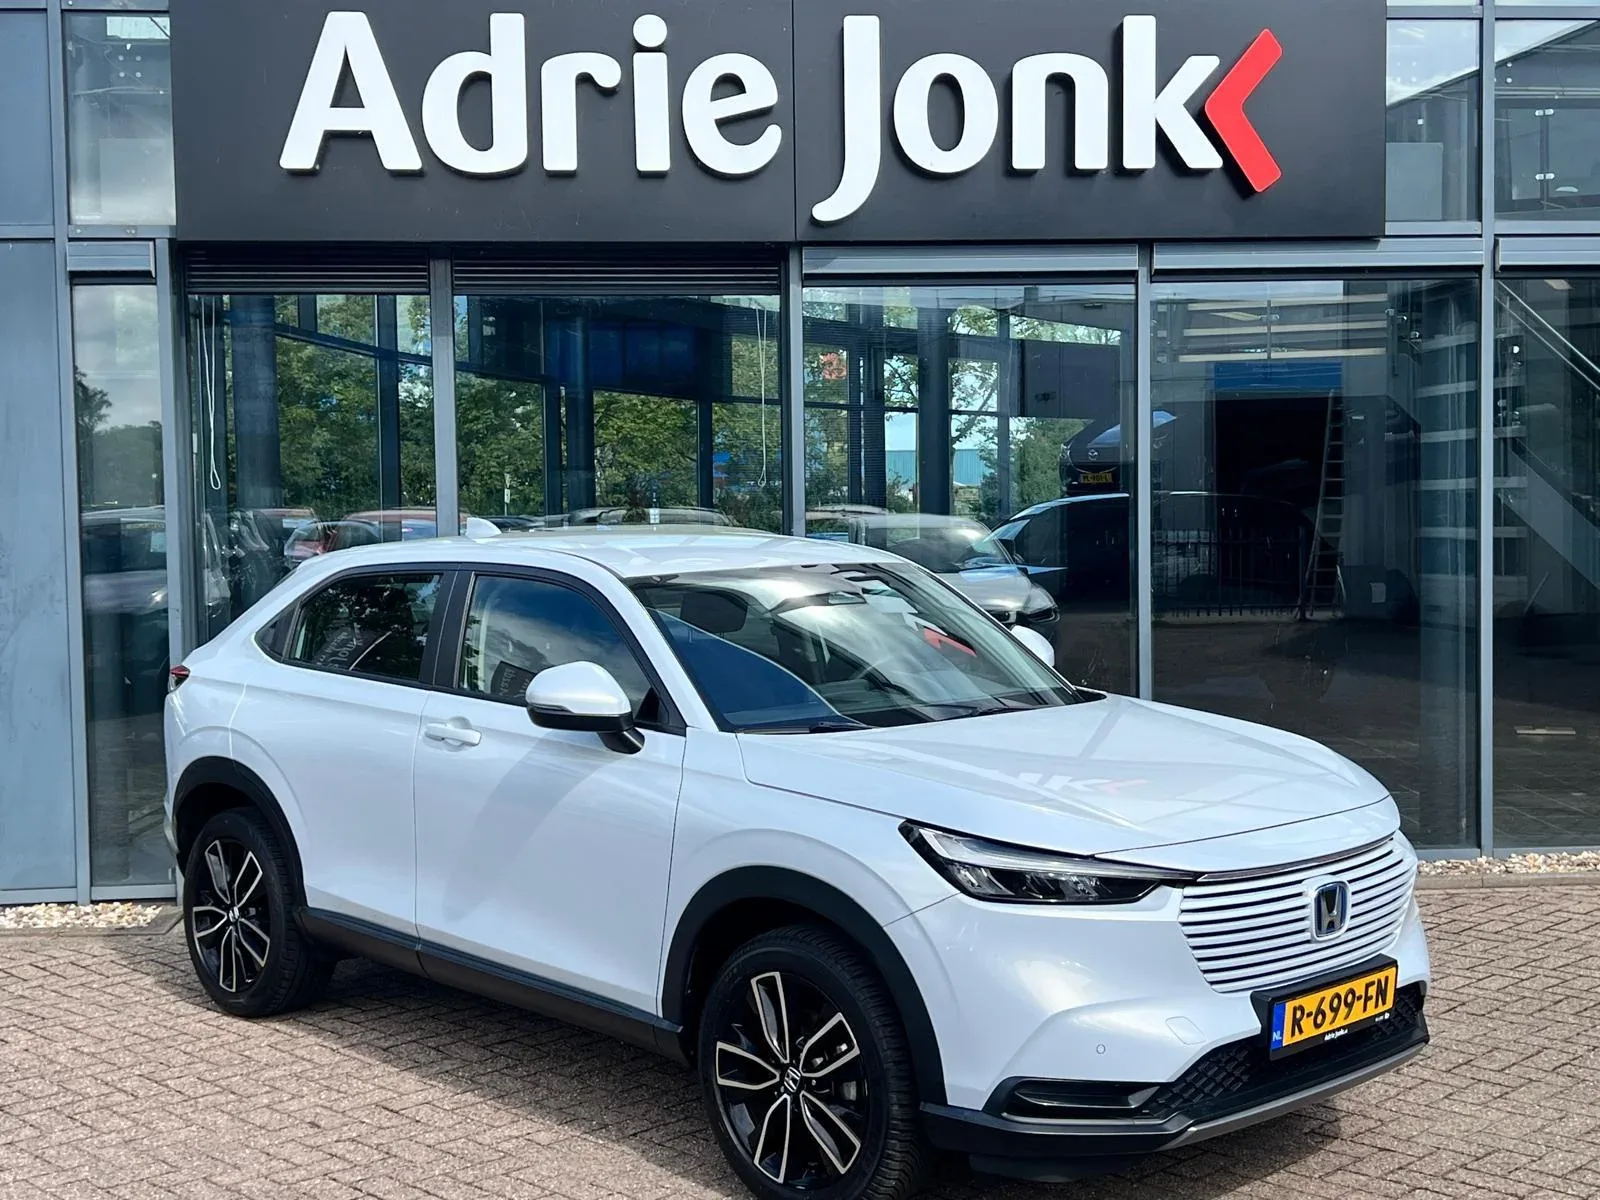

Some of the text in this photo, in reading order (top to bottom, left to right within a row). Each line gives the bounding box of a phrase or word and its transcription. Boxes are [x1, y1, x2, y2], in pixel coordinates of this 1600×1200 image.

[279, 11, 1224, 222] Adrie Jonk
[1272, 1031, 1282, 1042] NL
[1290, 975, 1389, 1038] R-699-FN
